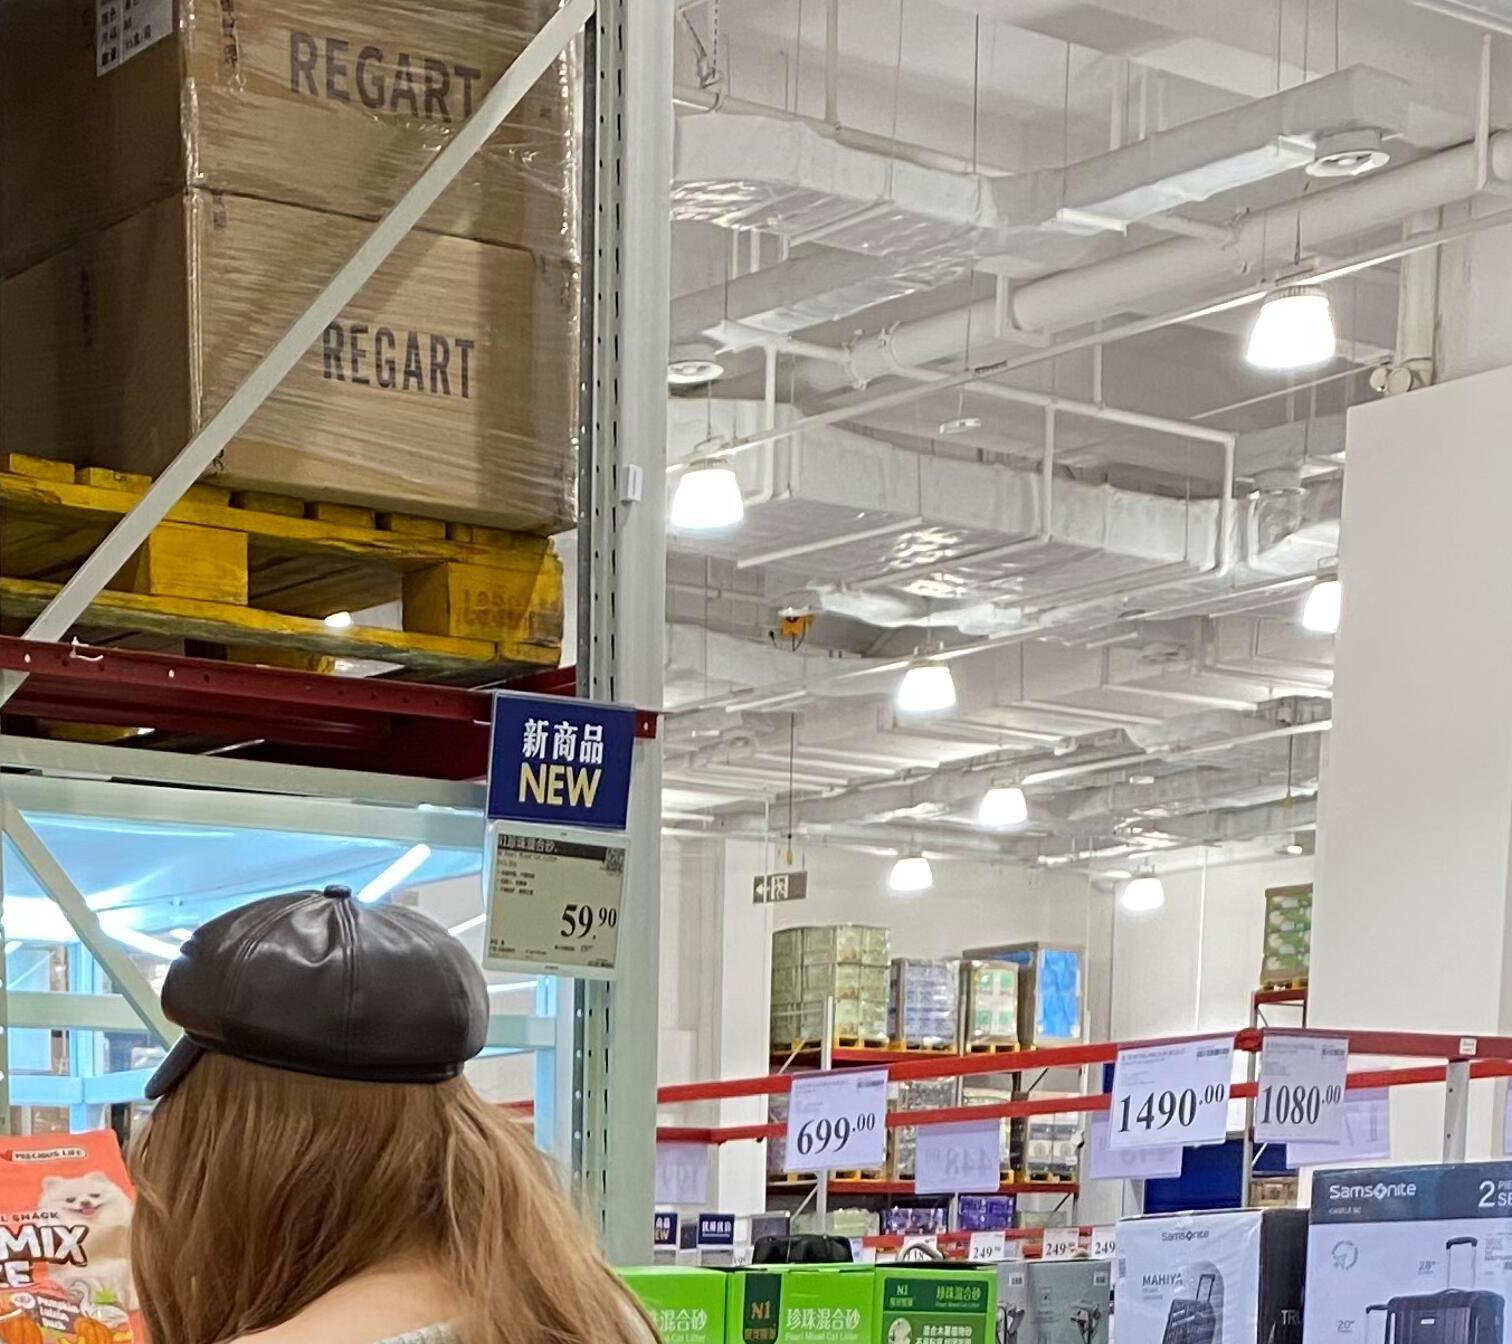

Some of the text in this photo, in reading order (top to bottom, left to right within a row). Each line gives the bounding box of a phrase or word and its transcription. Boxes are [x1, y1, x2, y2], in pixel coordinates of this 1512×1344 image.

[290, 32, 481, 122] REGART
[323, 321, 475, 400] REGART
[523, 718, 604, 764] 新商品
[518, 762, 603, 807] NEW
[560, 904, 618, 941] 59.90
[1119, 1083, 1226, 1133] 1490.00
[1261, 1084, 1342, 1126] 1080.00
[796, 1112, 876, 1156] 699.00
[1330, 1182, 1417, 1201] Samsonite
[1479, 1181, 1496, 1208] 2
[13, 1210, 60, 1223] SNACK
[1161, 1228, 1210, 1242] Samsonite
[1142, 1272, 1185, 1288] MAHIYA
[751, 1301, 771, 1320] N1
[786, 1307, 861, 1331] 珍珠混合砂
